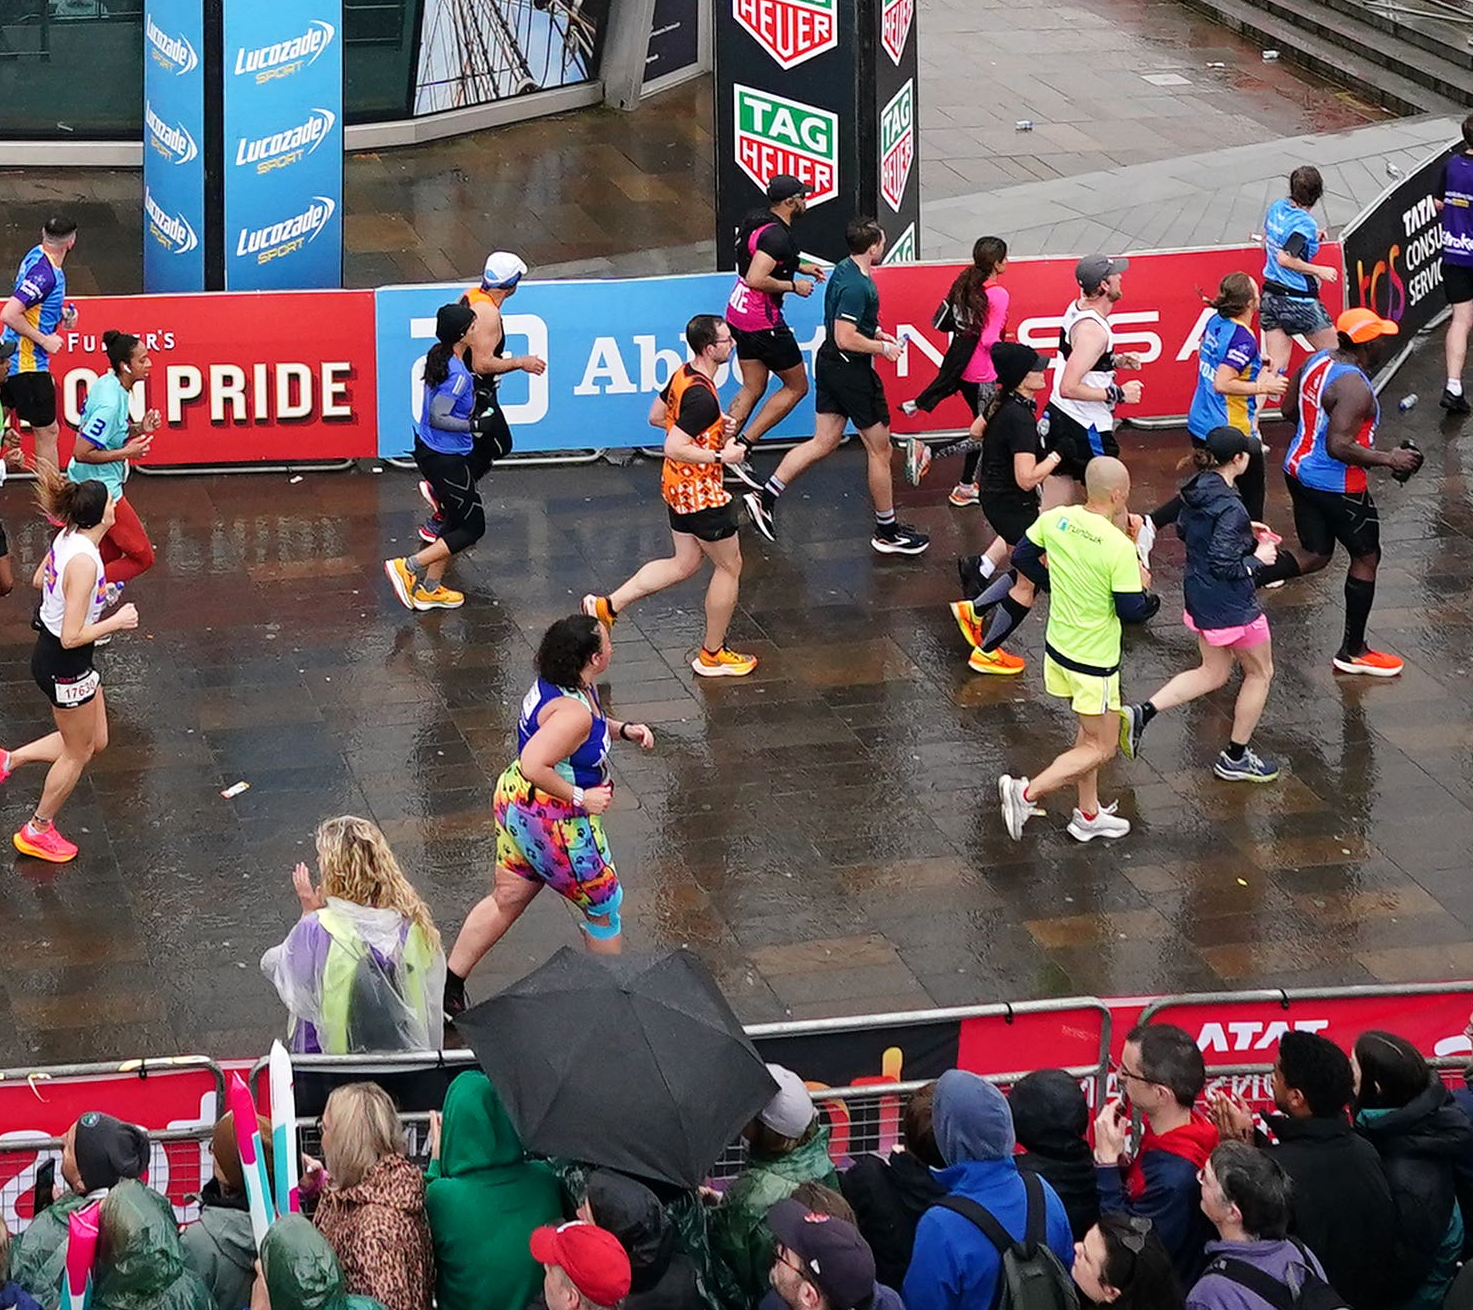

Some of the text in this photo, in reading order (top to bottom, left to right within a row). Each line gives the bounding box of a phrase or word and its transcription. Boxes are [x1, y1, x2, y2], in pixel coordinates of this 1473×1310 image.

[234, 28, 323, 77] Lucozade
[255, 60, 305, 84] SPORT
[235, 114, 324, 166] Lucozade
[744, 97, 827, 152] TAG
[883, 96, 913, 149] TAG
[256, 150, 305, 175] SPORT
[236, 203, 324, 257] Lucozade
[1401, 195, 1438, 232] TATA
[257, 236, 305, 265] SPORT
[167, 362, 350, 421] PRIDE
